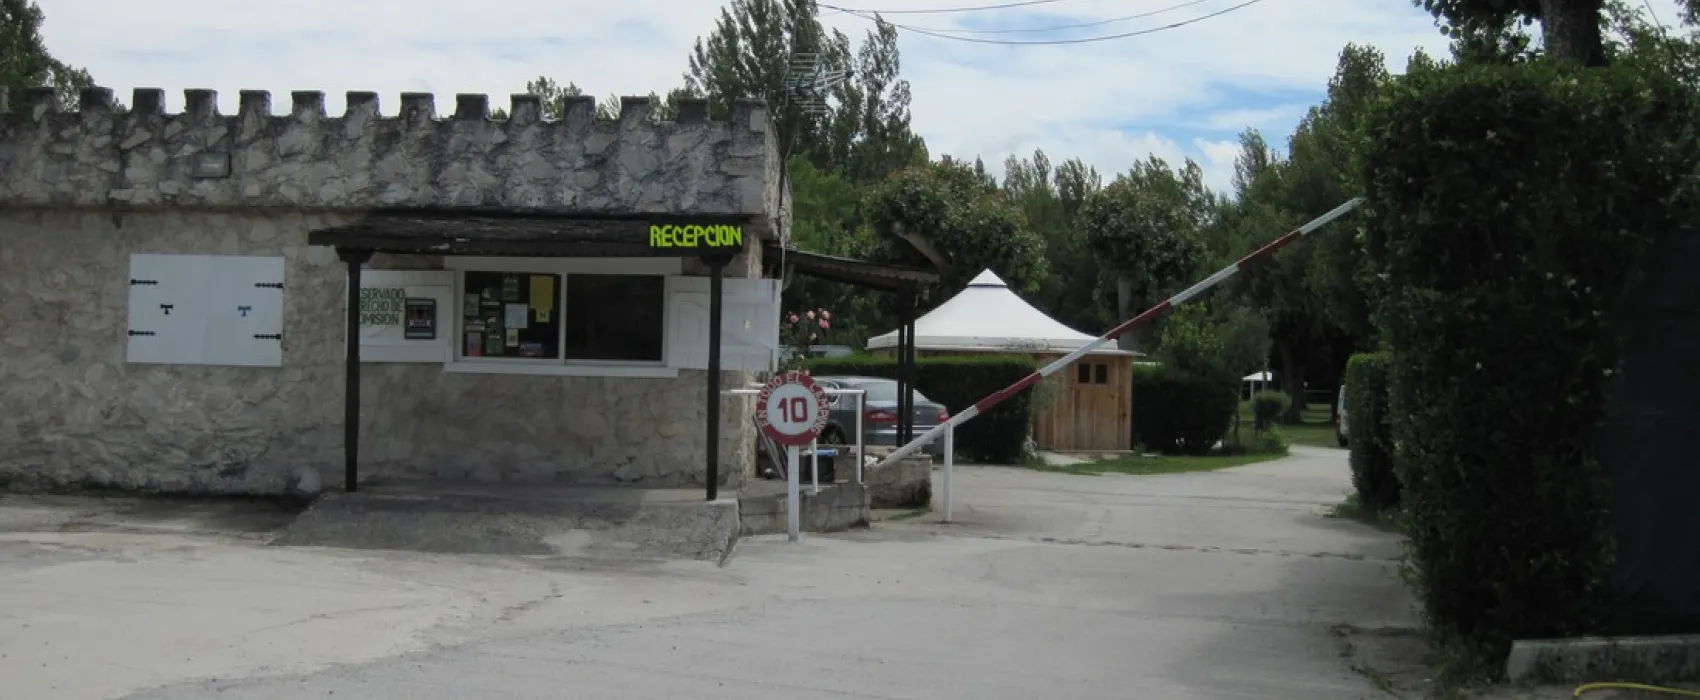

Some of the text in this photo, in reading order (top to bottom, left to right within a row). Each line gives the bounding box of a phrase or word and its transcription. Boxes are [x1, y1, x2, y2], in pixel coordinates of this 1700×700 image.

[649, 224, 743, 247] RECEPCION
[360, 287, 406, 299] SERVADO
[360, 300, 390, 311] RECHO
[757, 370, 829, 436] EN TODO EL CAMPING
[776, 396, 808, 423] 10
